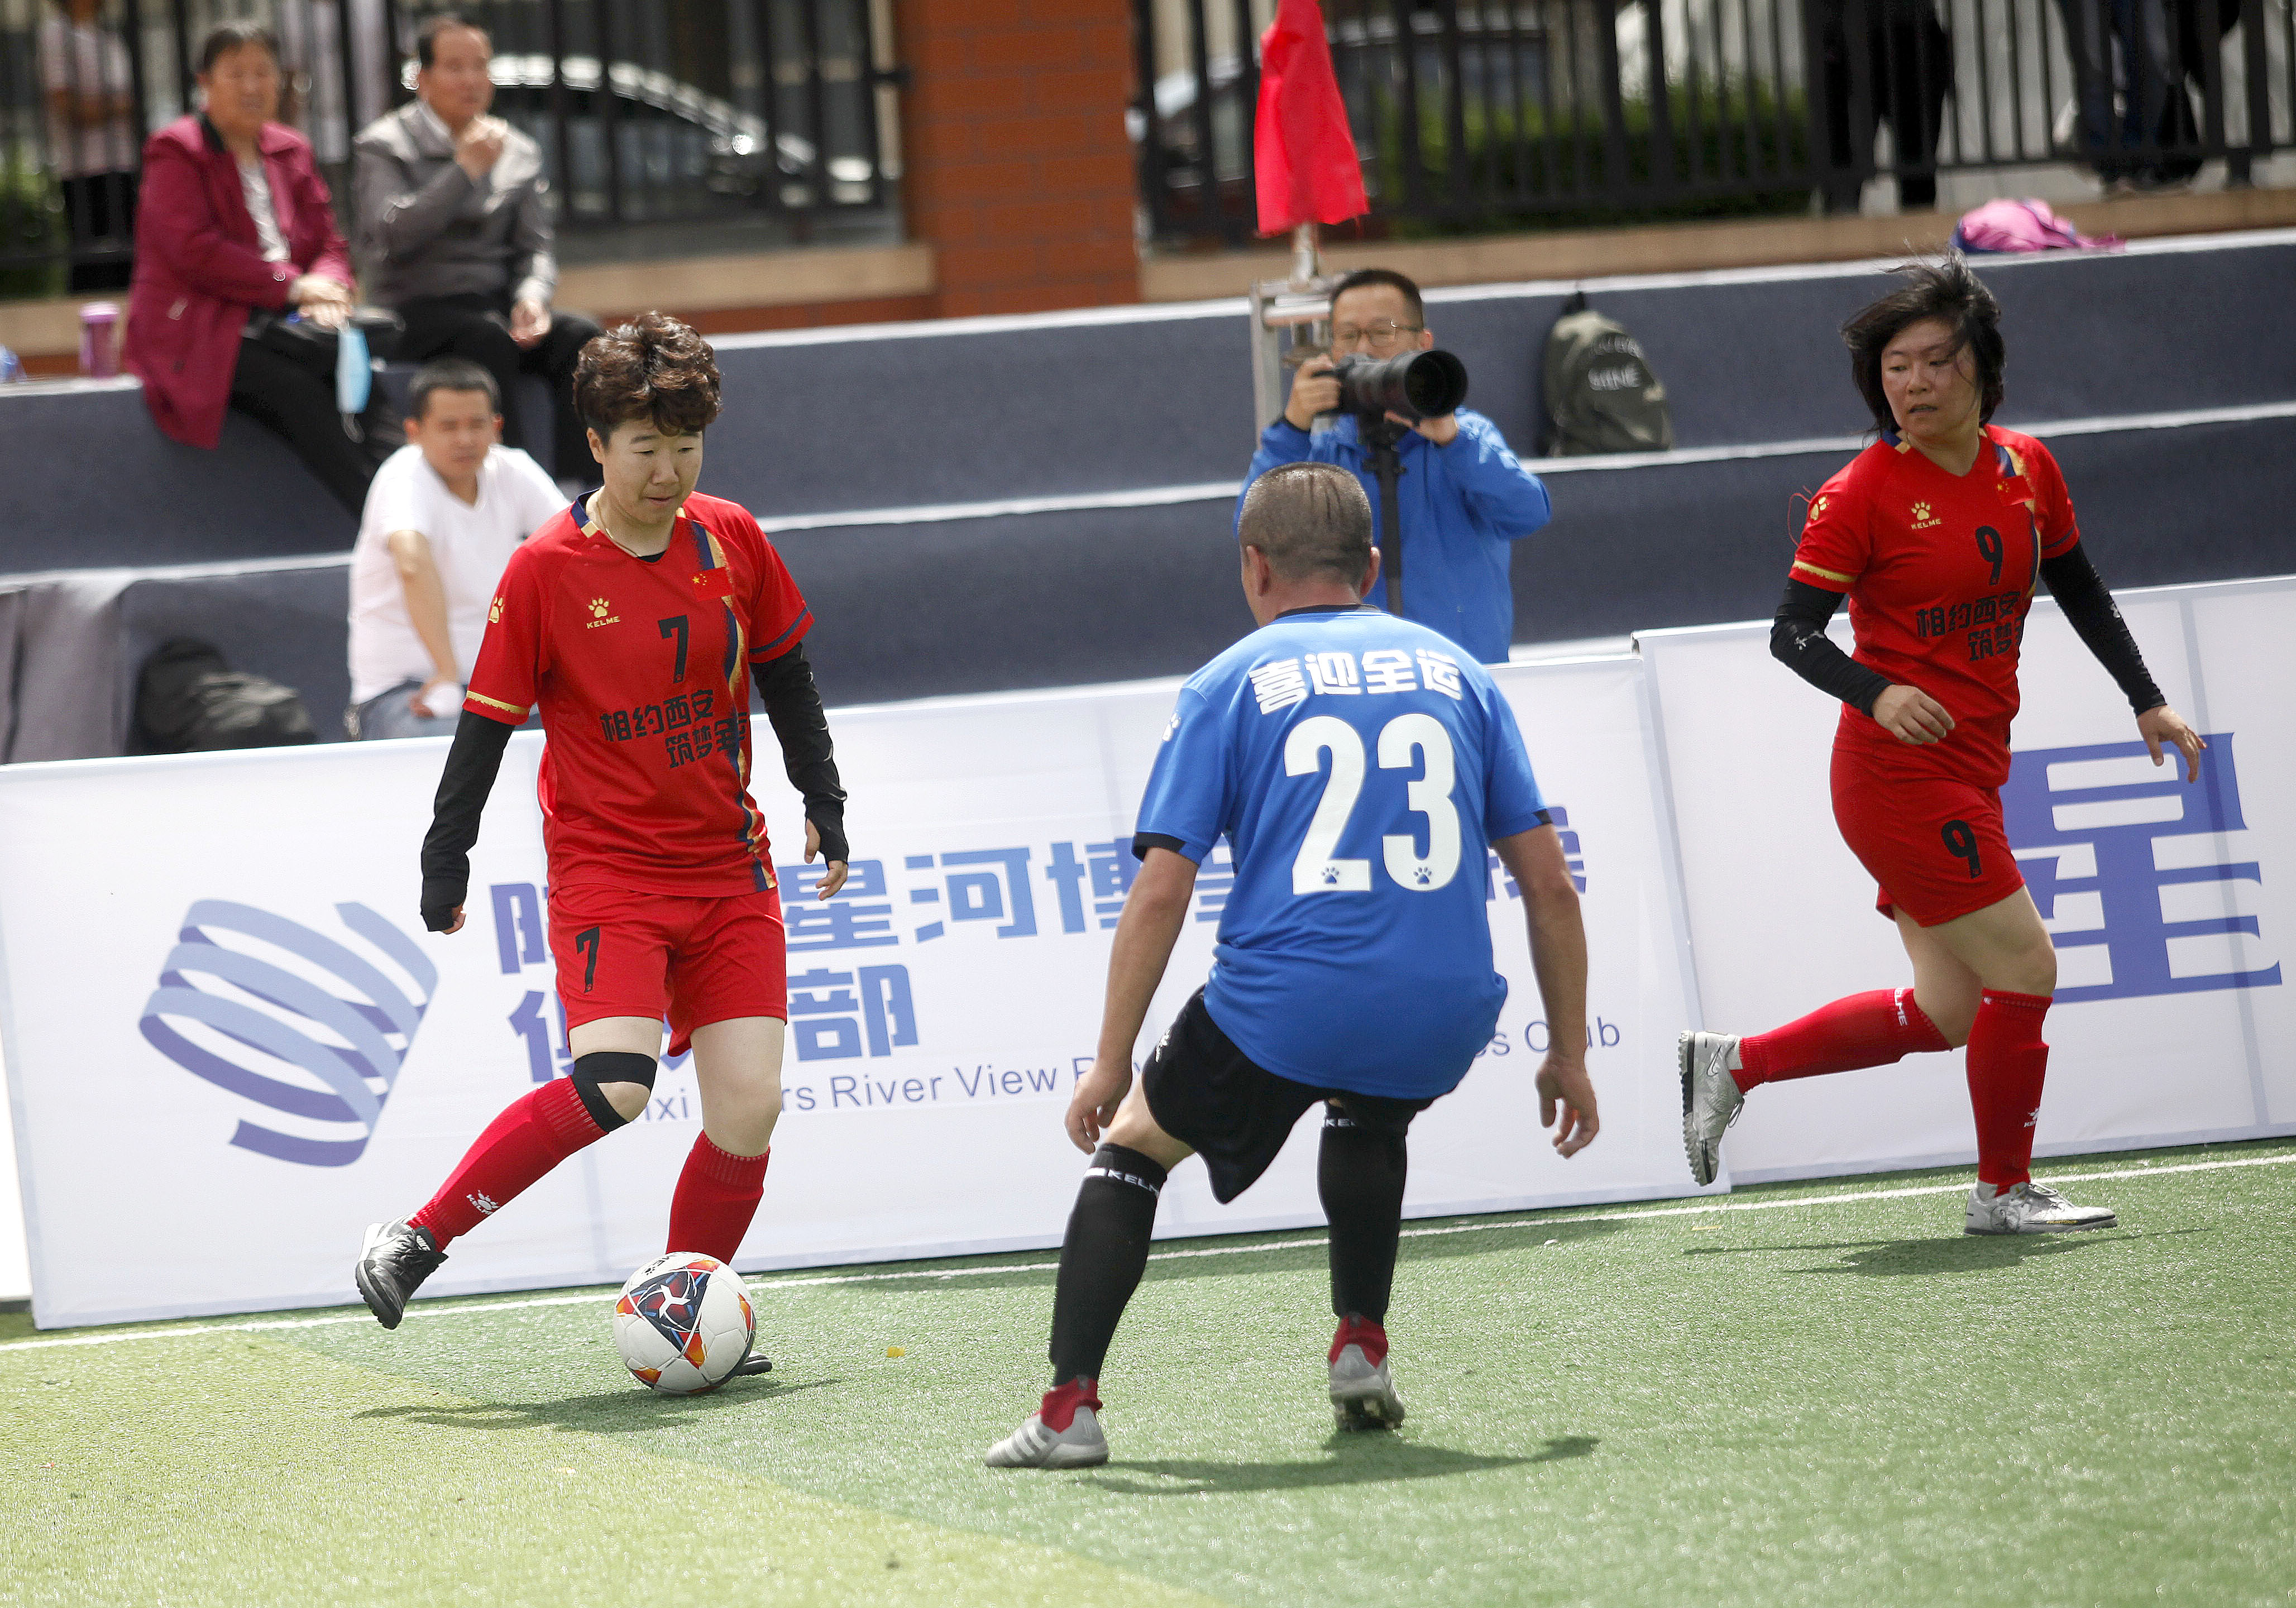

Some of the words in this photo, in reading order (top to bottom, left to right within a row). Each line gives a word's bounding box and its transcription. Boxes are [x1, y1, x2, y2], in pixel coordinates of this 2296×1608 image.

[1911, 519, 1941, 530] KELME
[1976, 525, 2003, 586] 9
[587, 616, 620, 629] KELME
[1916, 591, 2020, 637] 相约西安
[658, 615, 688, 683] 7
[1248, 649, 1463, 715] 喜迎全运
[599, 689, 714, 742] 相约西安
[1284, 713, 1461, 895] 23
[1941, 820, 1983, 879] 9
[576, 926, 599, 993] 7
[830, 1074, 941, 1108] River
[954, 1064, 1056, 1098] View
